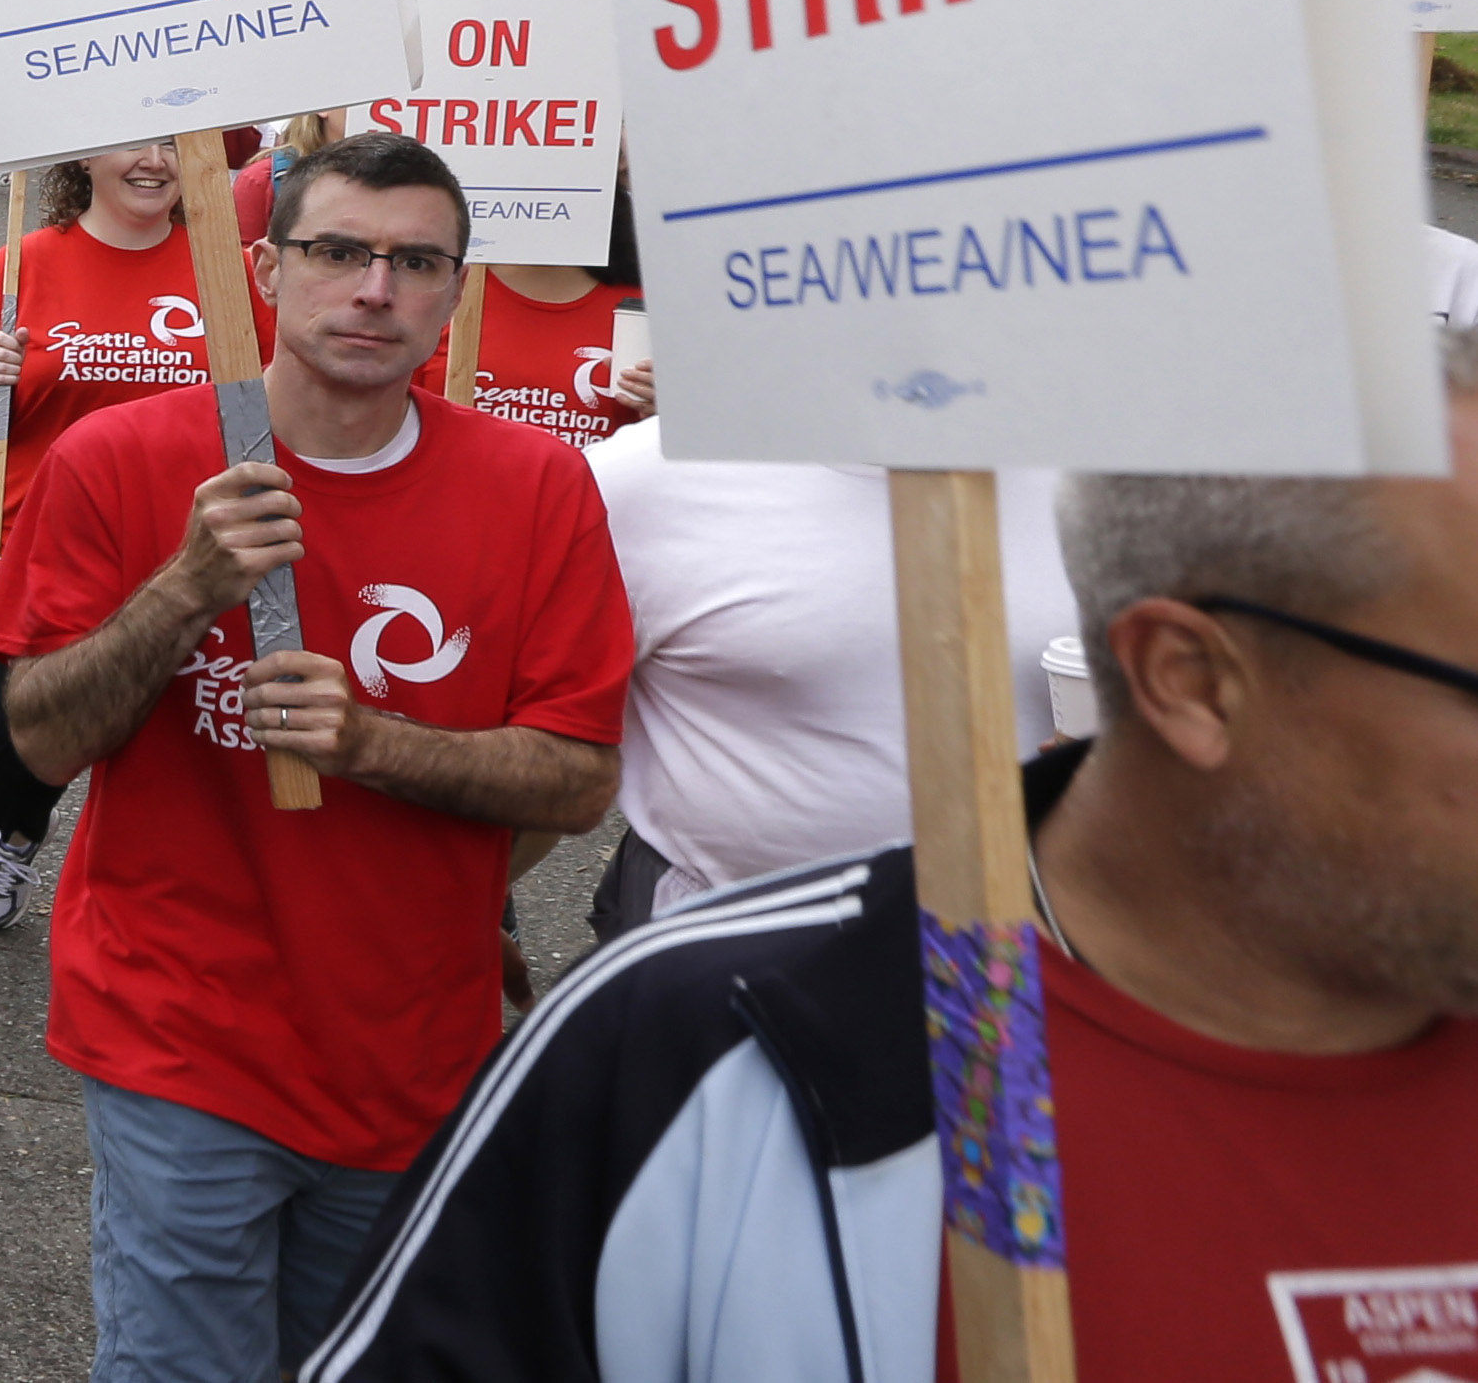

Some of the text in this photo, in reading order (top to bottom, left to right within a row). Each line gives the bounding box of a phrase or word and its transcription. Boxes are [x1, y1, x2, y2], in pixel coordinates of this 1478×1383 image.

[24, 0, 331, 80] SEA/WEA/NEA
[448, 19, 531, 68] ON
[366, 98, 599, 148] STRIKE!
[465, 200, 571, 221] EA/NEA
[724, 205, 1192, 312] SEA/WEA/NEA
[46, 321, 147, 352] Seattle
[62, 346, 193, 366] Education
[58, 364, 208, 385] Association
